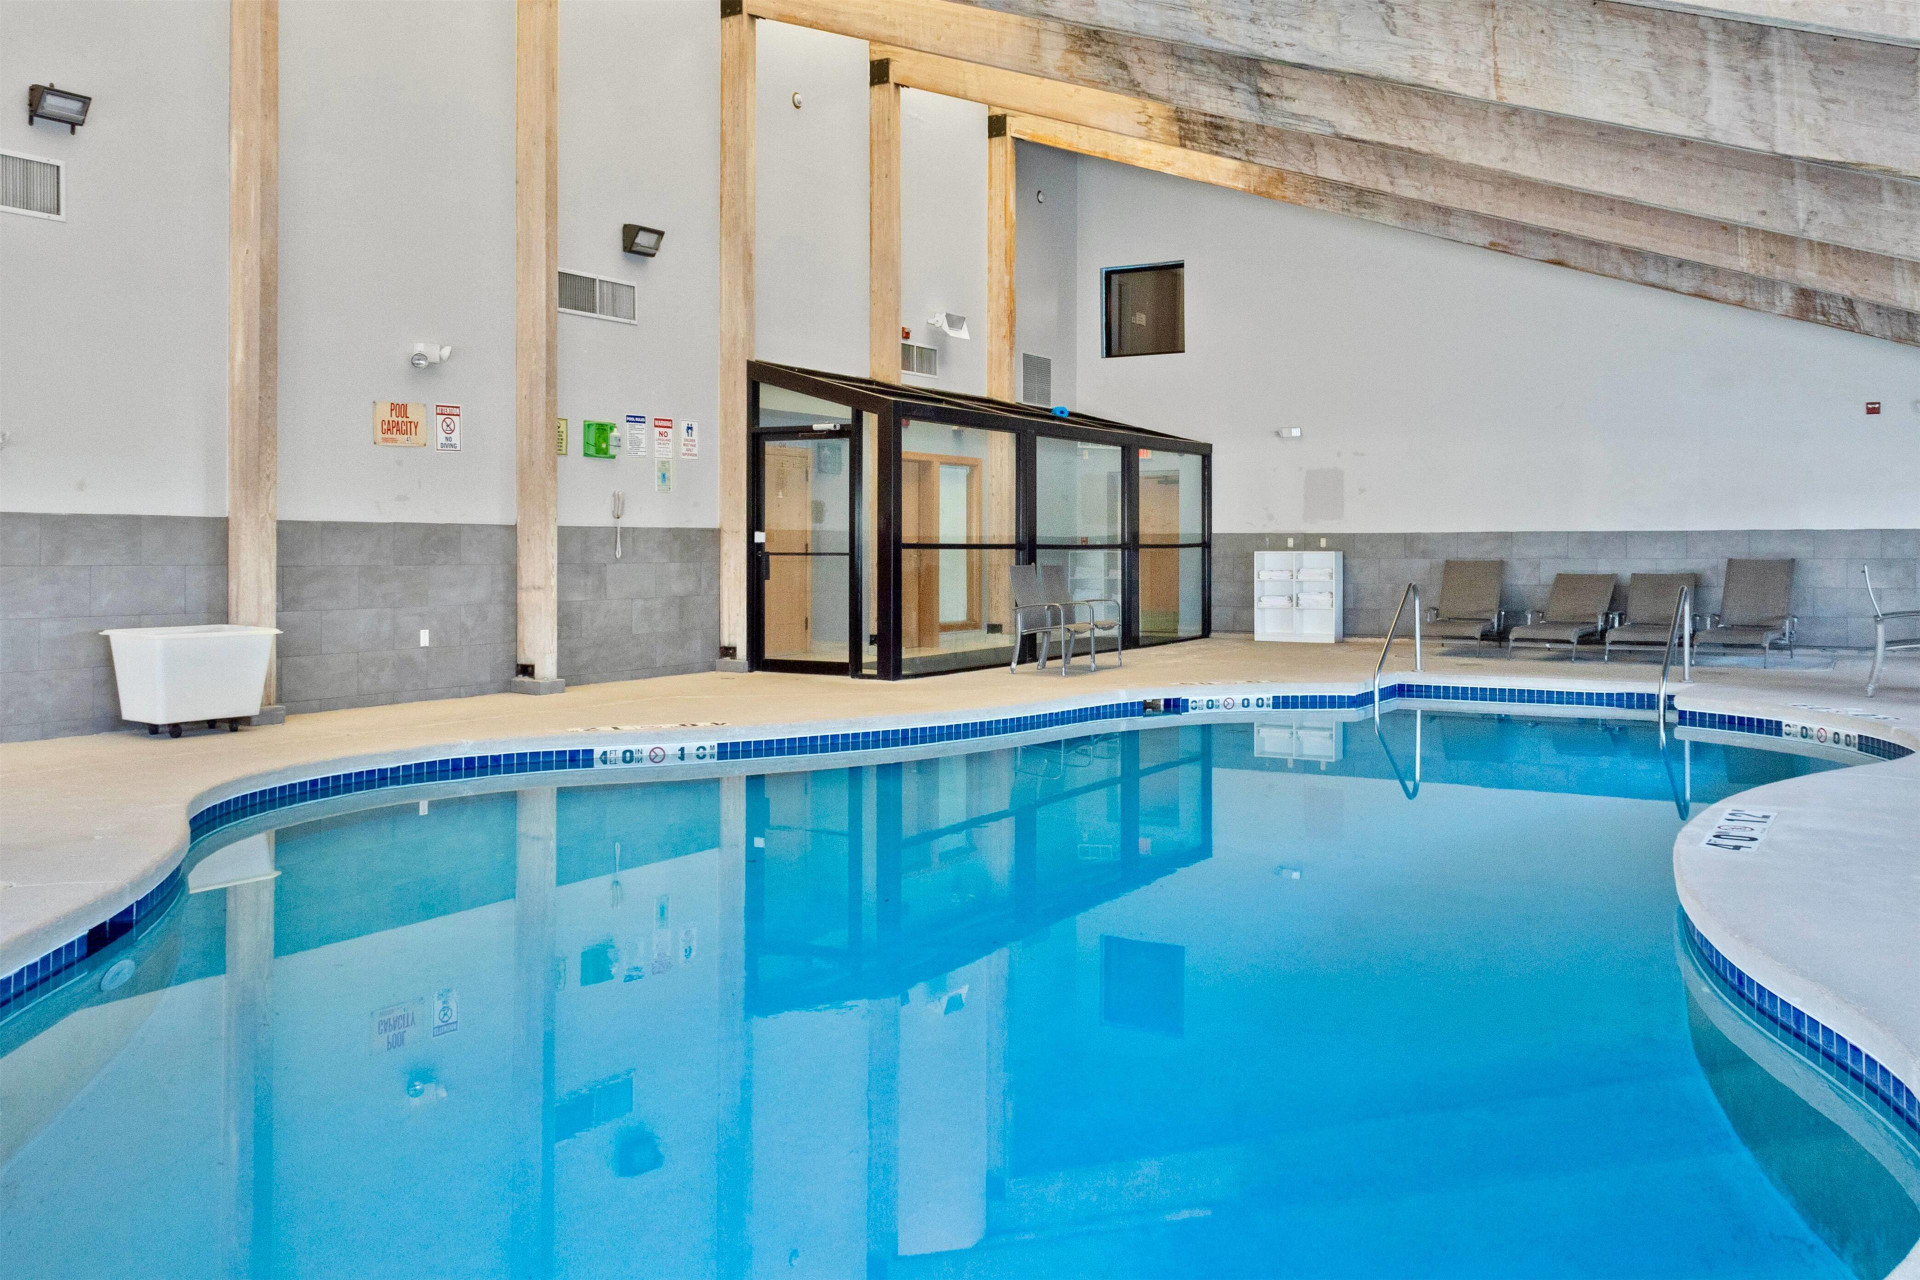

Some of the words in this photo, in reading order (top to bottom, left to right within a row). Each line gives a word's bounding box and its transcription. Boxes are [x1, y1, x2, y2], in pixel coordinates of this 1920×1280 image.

[390, 402, 409, 419] POOL
[381, 419, 419, 436] CAPACITY
[658, 430, 668, 438] NO
